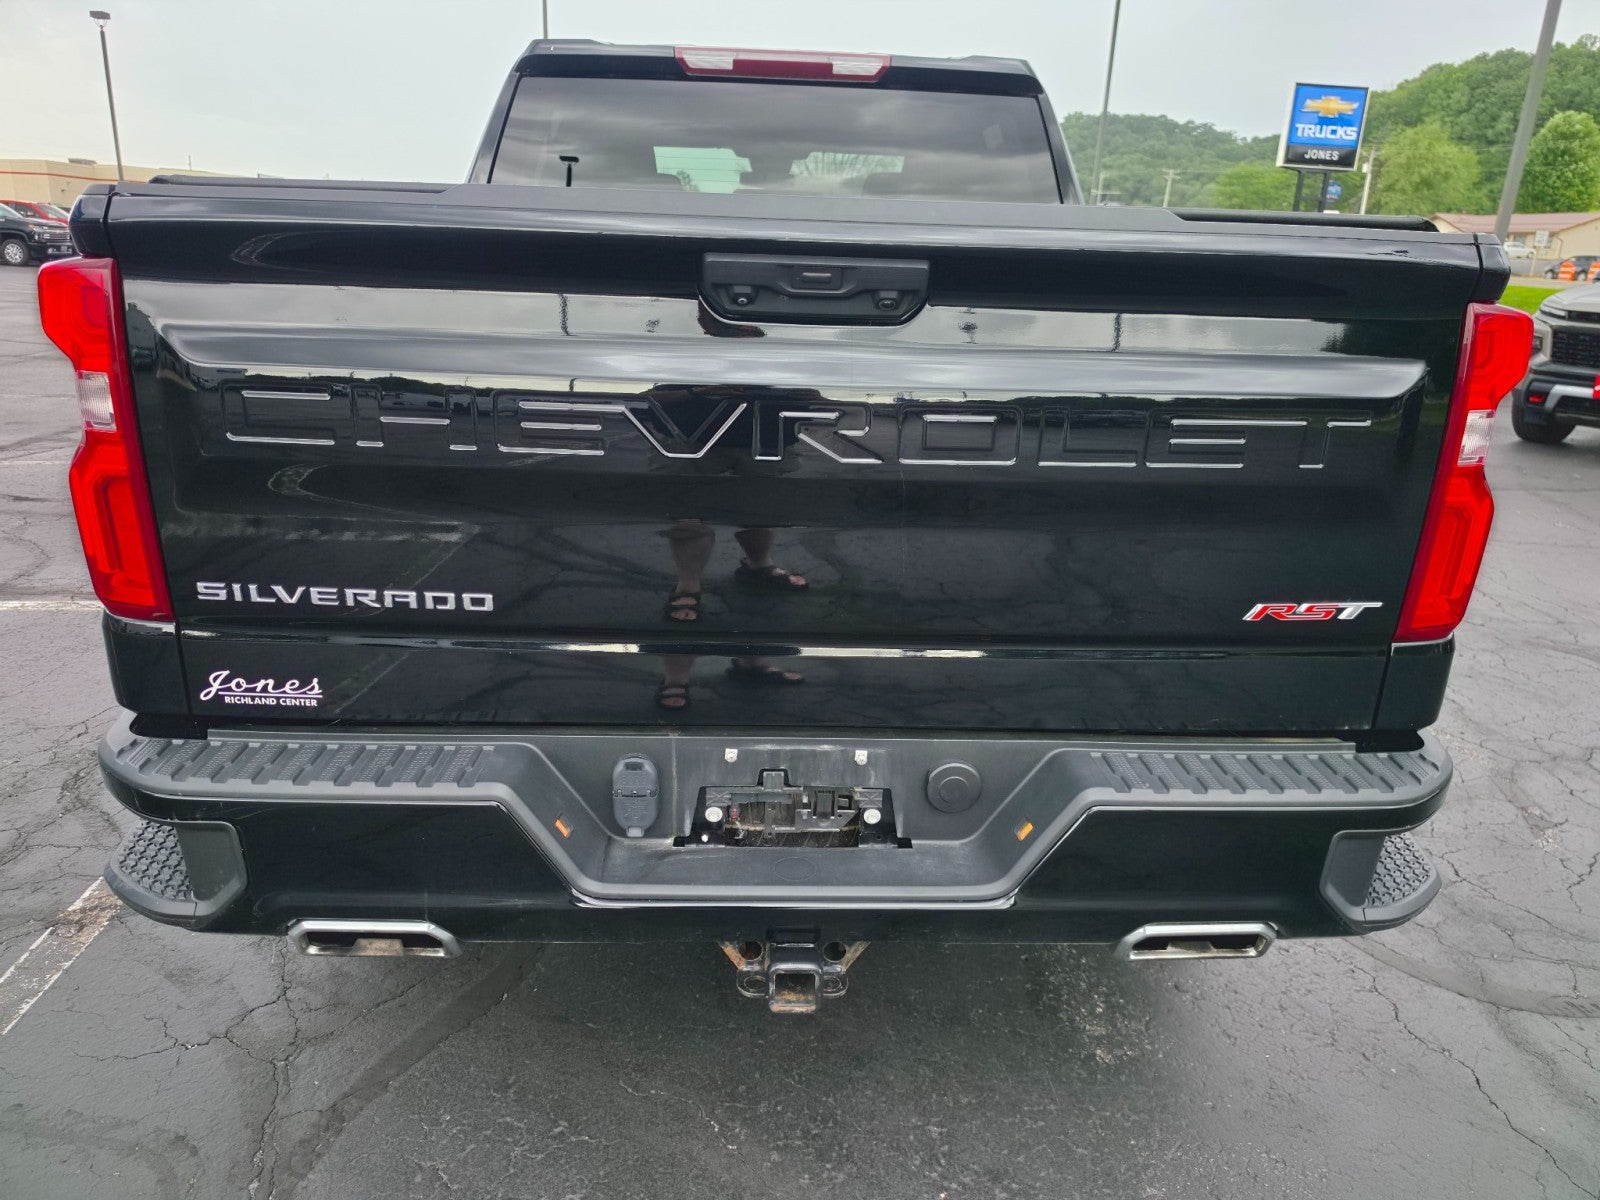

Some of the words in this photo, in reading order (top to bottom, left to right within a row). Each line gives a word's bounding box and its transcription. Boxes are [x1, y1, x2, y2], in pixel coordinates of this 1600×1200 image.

[1295, 123, 1358, 140] TRUCKS
[1304, 149, 1340, 161] JONES
[219, 380, 1372, 469] CHEVROLET
[196, 581, 494, 612] SILVERADO
[1242, 602, 1384, 621] RST
[200, 670, 323, 701] Jones
[224, 695, 277, 706] RICHLAND
[279, 696, 318, 707] CENTER
